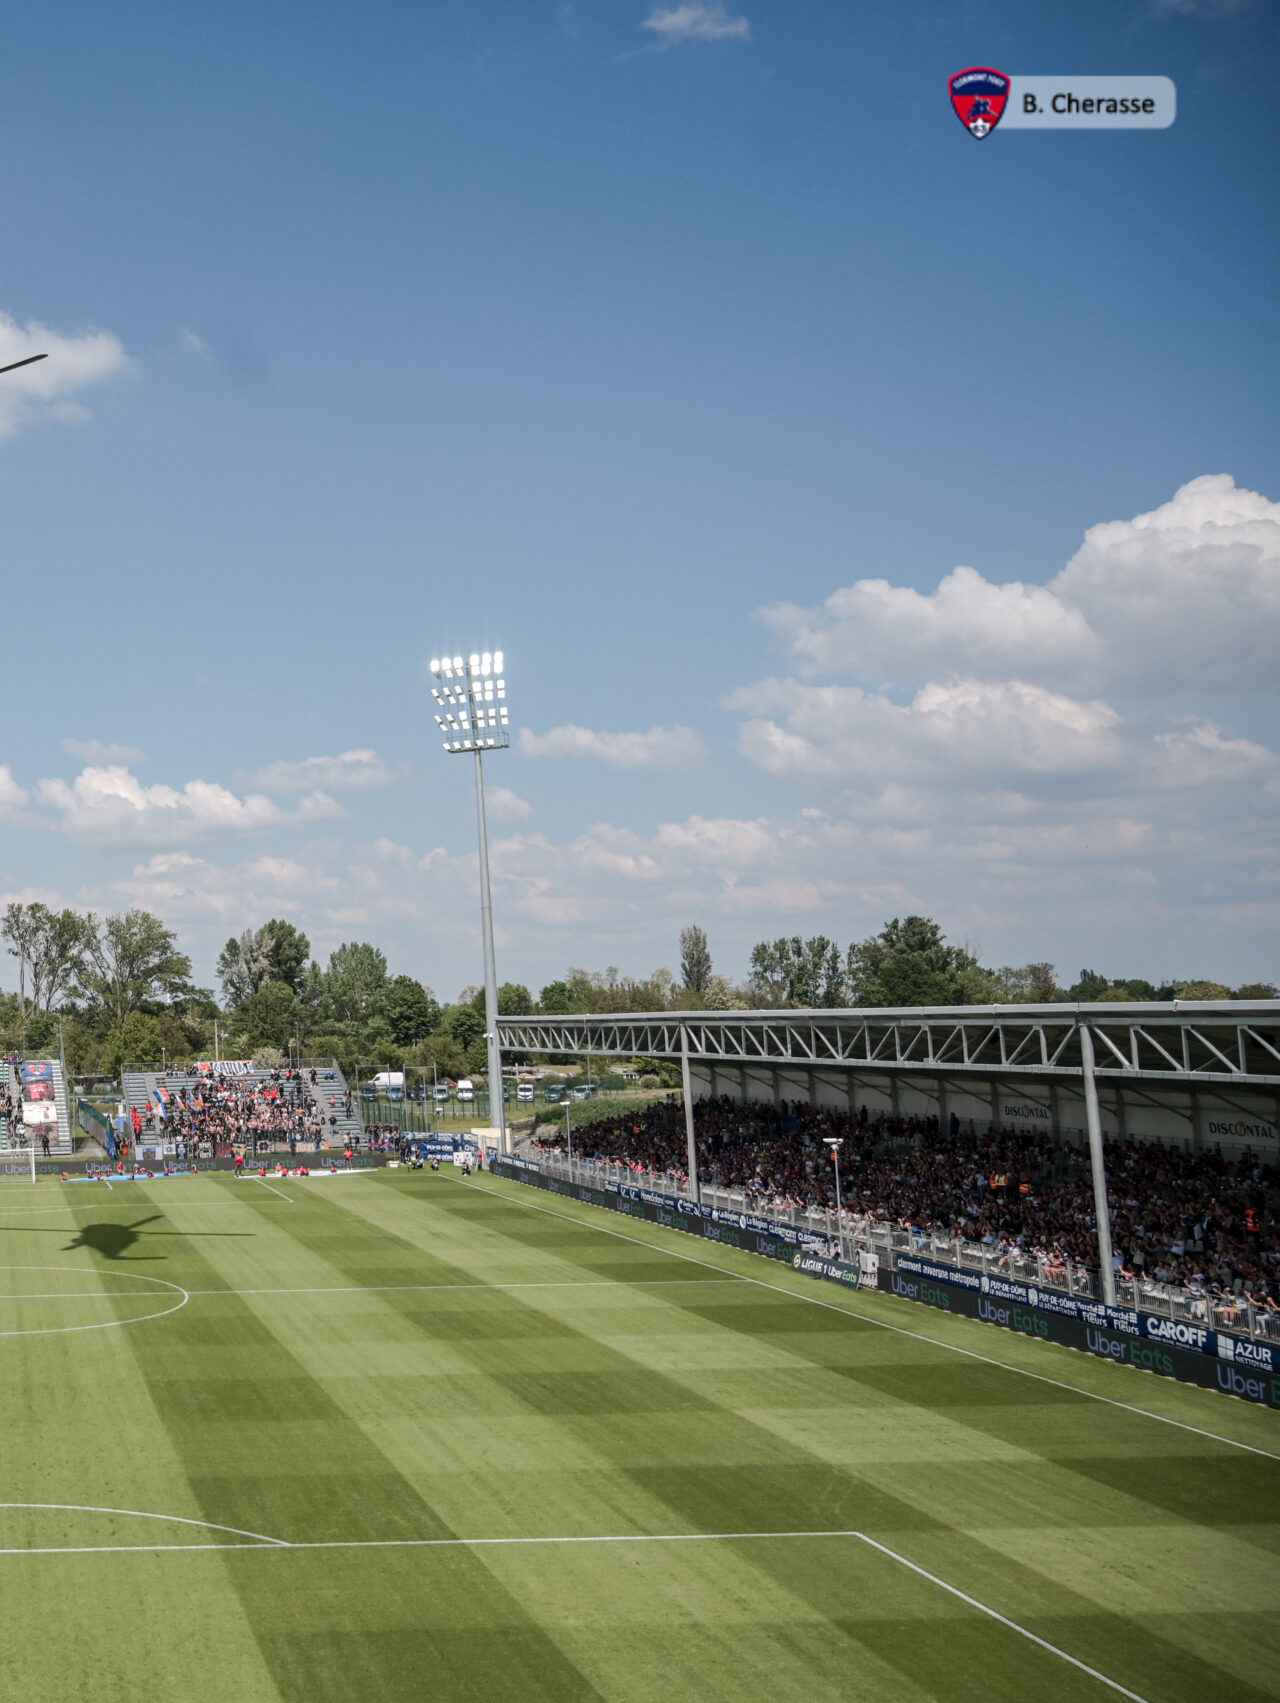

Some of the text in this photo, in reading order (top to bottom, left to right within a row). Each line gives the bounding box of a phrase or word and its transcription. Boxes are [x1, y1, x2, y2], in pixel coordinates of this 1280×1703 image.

[1004, 1104, 1050, 1119] DISCONTAL
[1209, 1120, 1276, 1139] DISCONTAL
[243, 1159, 269, 1168] Uber
[703, 1221, 720, 1239] Uber
[752, 1217, 768, 1229] Région
[756, 1236, 776, 1256] Uber
[801, 1258, 823, 1272] LIGUE
[828, 1264, 843, 1278] Uber
[842, 1268, 857, 1283] Eats
[897, 1257, 980, 1287] clermont auvergne métropole
[891, 1274, 950, 1307] Uber Eats
[990, 1281, 1028, 1297] PUY-DE-DÔME
[1038, 1293, 1077, 1310] PUY-DE-DÔME
[978, 1298, 1049, 1336] Uber Eats
[1082, 1312, 1108, 1327] Fleurs
[1106, 1308, 1130, 1322] Marché
[1114, 1319, 1139, 1336] Fleurs
[1146, 1317, 1207, 1347] CAROFF
[1086, 1327, 1127, 1358] Uber
[1129, 1340, 1174, 1373] Eats
[1235, 1342, 1272, 1363] AZUR
[1216, 1363, 1266, 1399] Uber
